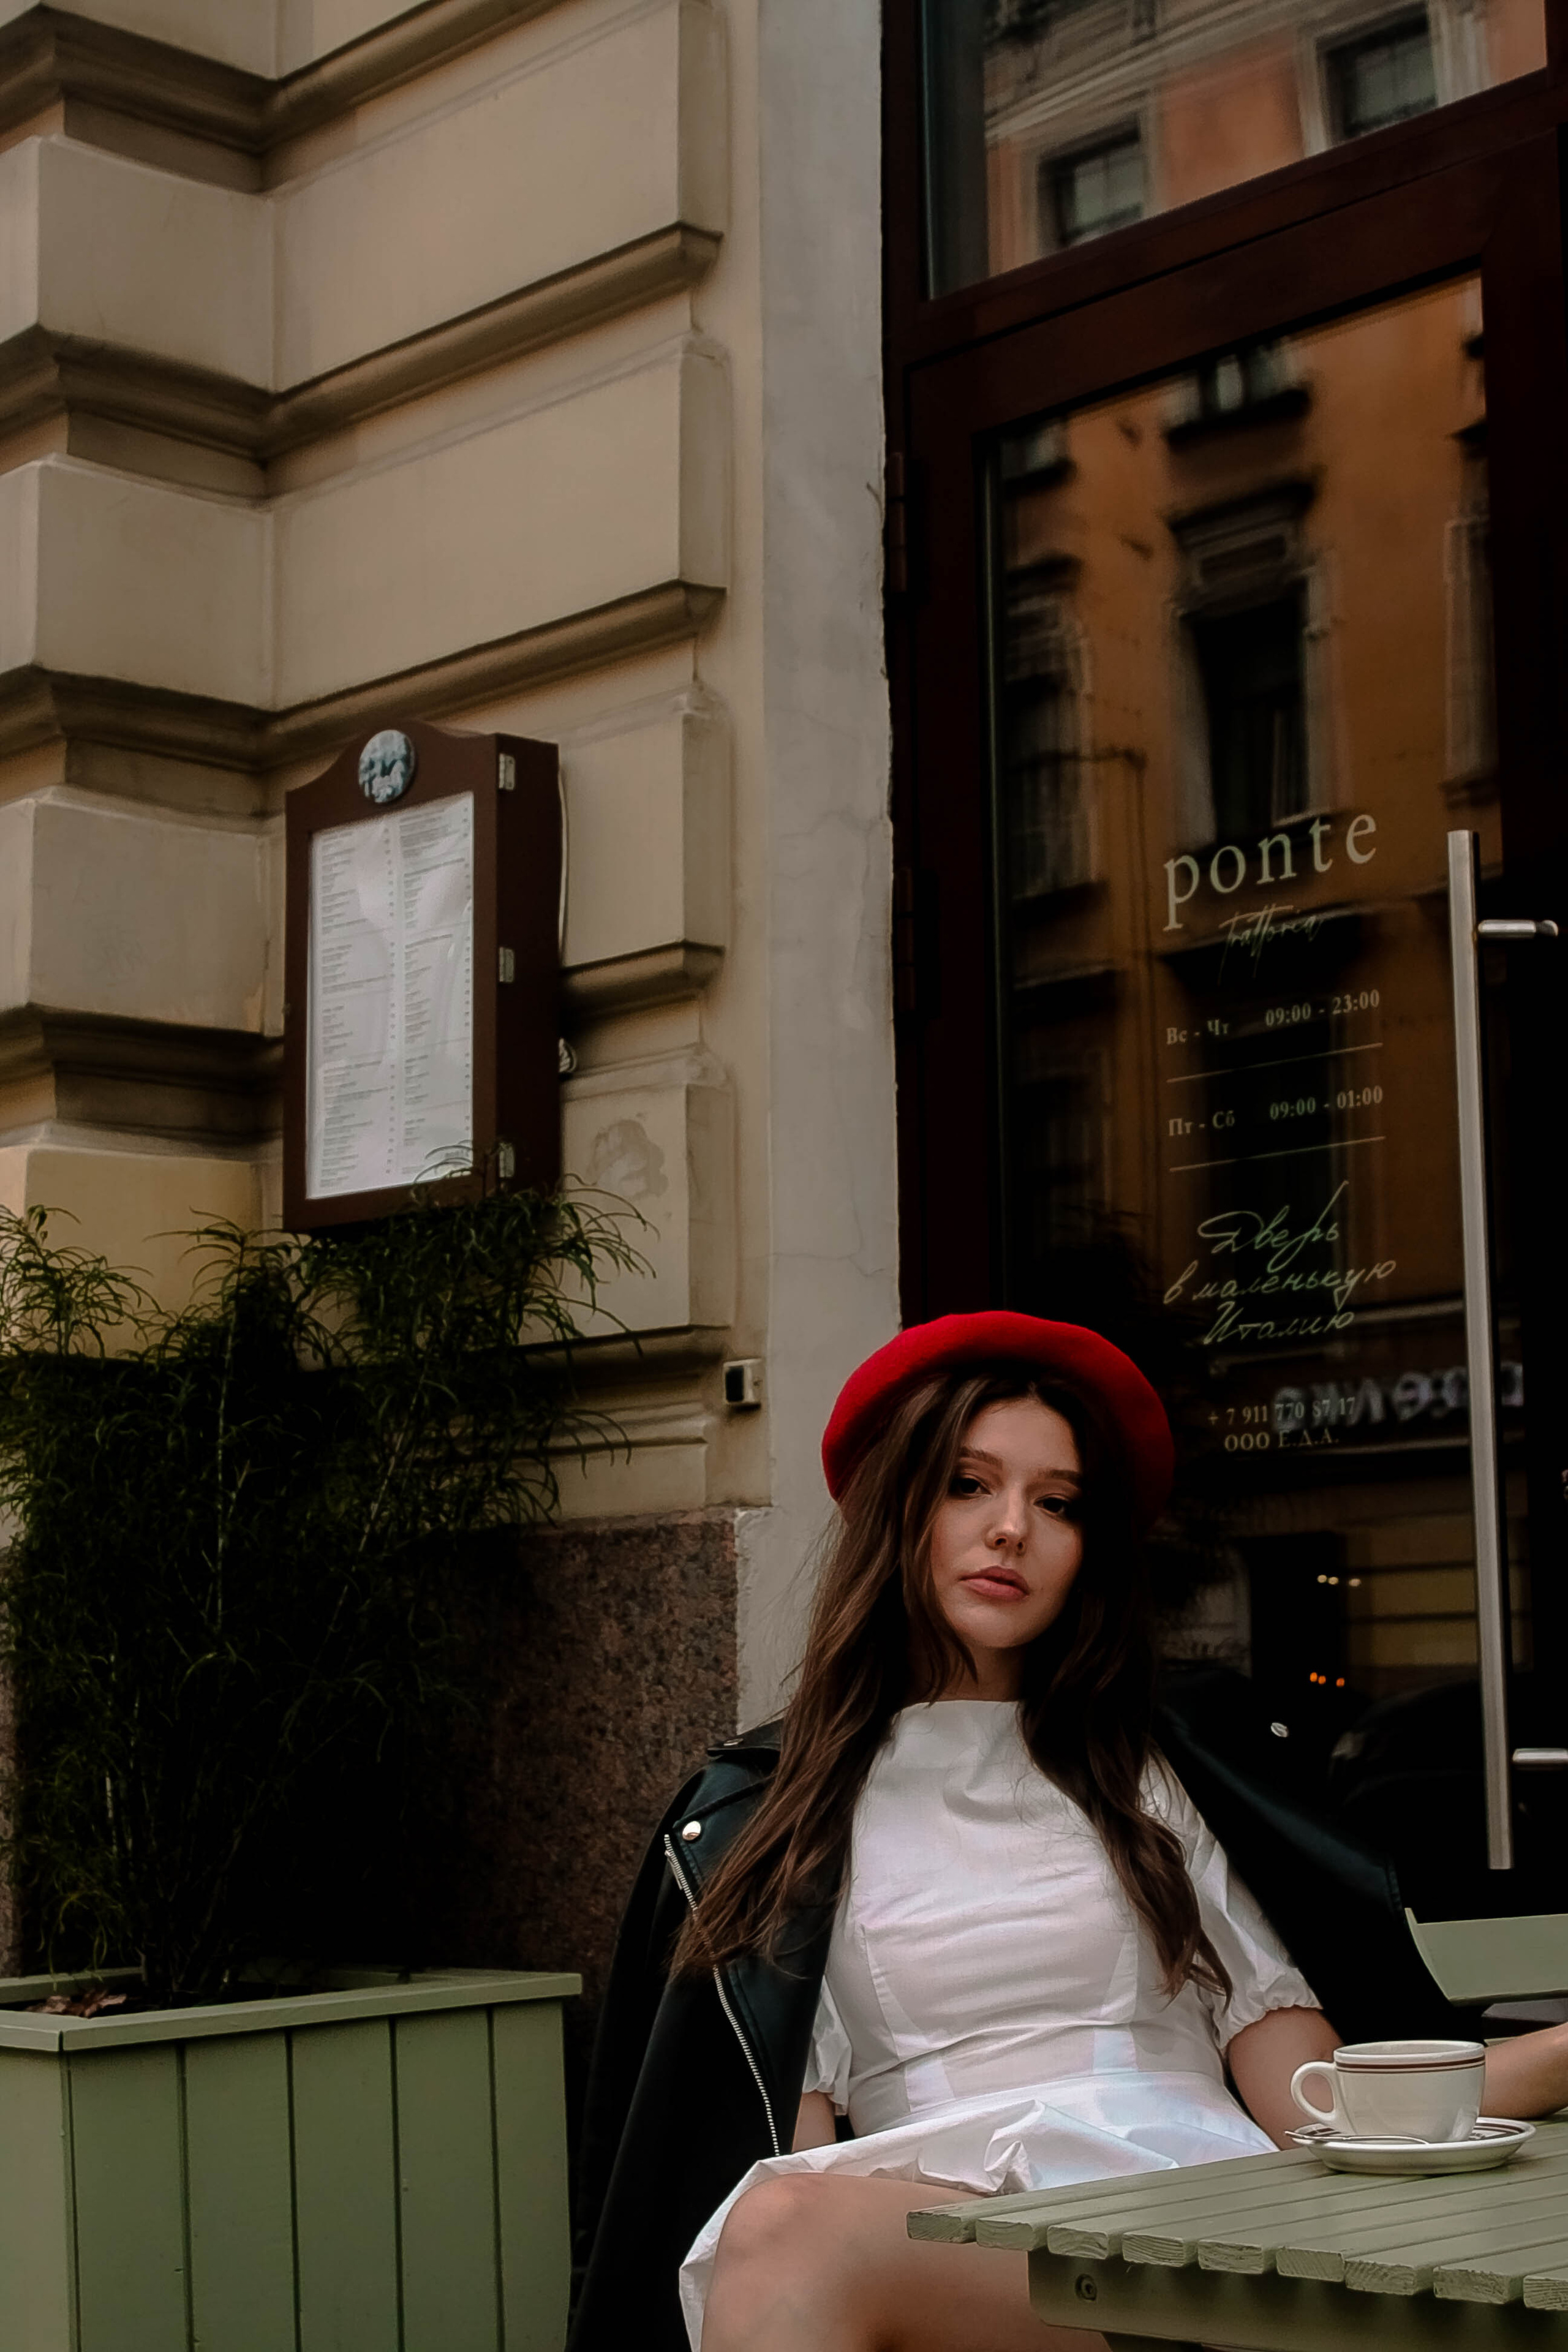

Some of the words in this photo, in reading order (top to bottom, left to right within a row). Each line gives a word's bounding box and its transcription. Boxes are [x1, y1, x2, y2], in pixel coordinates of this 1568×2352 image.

[1164, 813, 1378, 931] ponte
[1166, 1027, 1187, 1045] Вс
[1207, 1019, 1229, 1036] Чт
[1265, 1003, 1312, 1027] 09:00
[1332, 989, 1381, 1015] 23:00
[1169, 1117, 1192, 1137] Пт
[1212, 1110, 1235, 1129] Сб
[1270, 1097, 1316, 1120] 09:00
[1337, 1085, 1384, 1110] 01:00
[1197, 1180, 1349, 1274] Дверь
[1192, 1259, 1398, 1311] маленькую
[1202, 1301, 1355, 1346] Италию
[1242, 1404, 1268, 1423] 911
